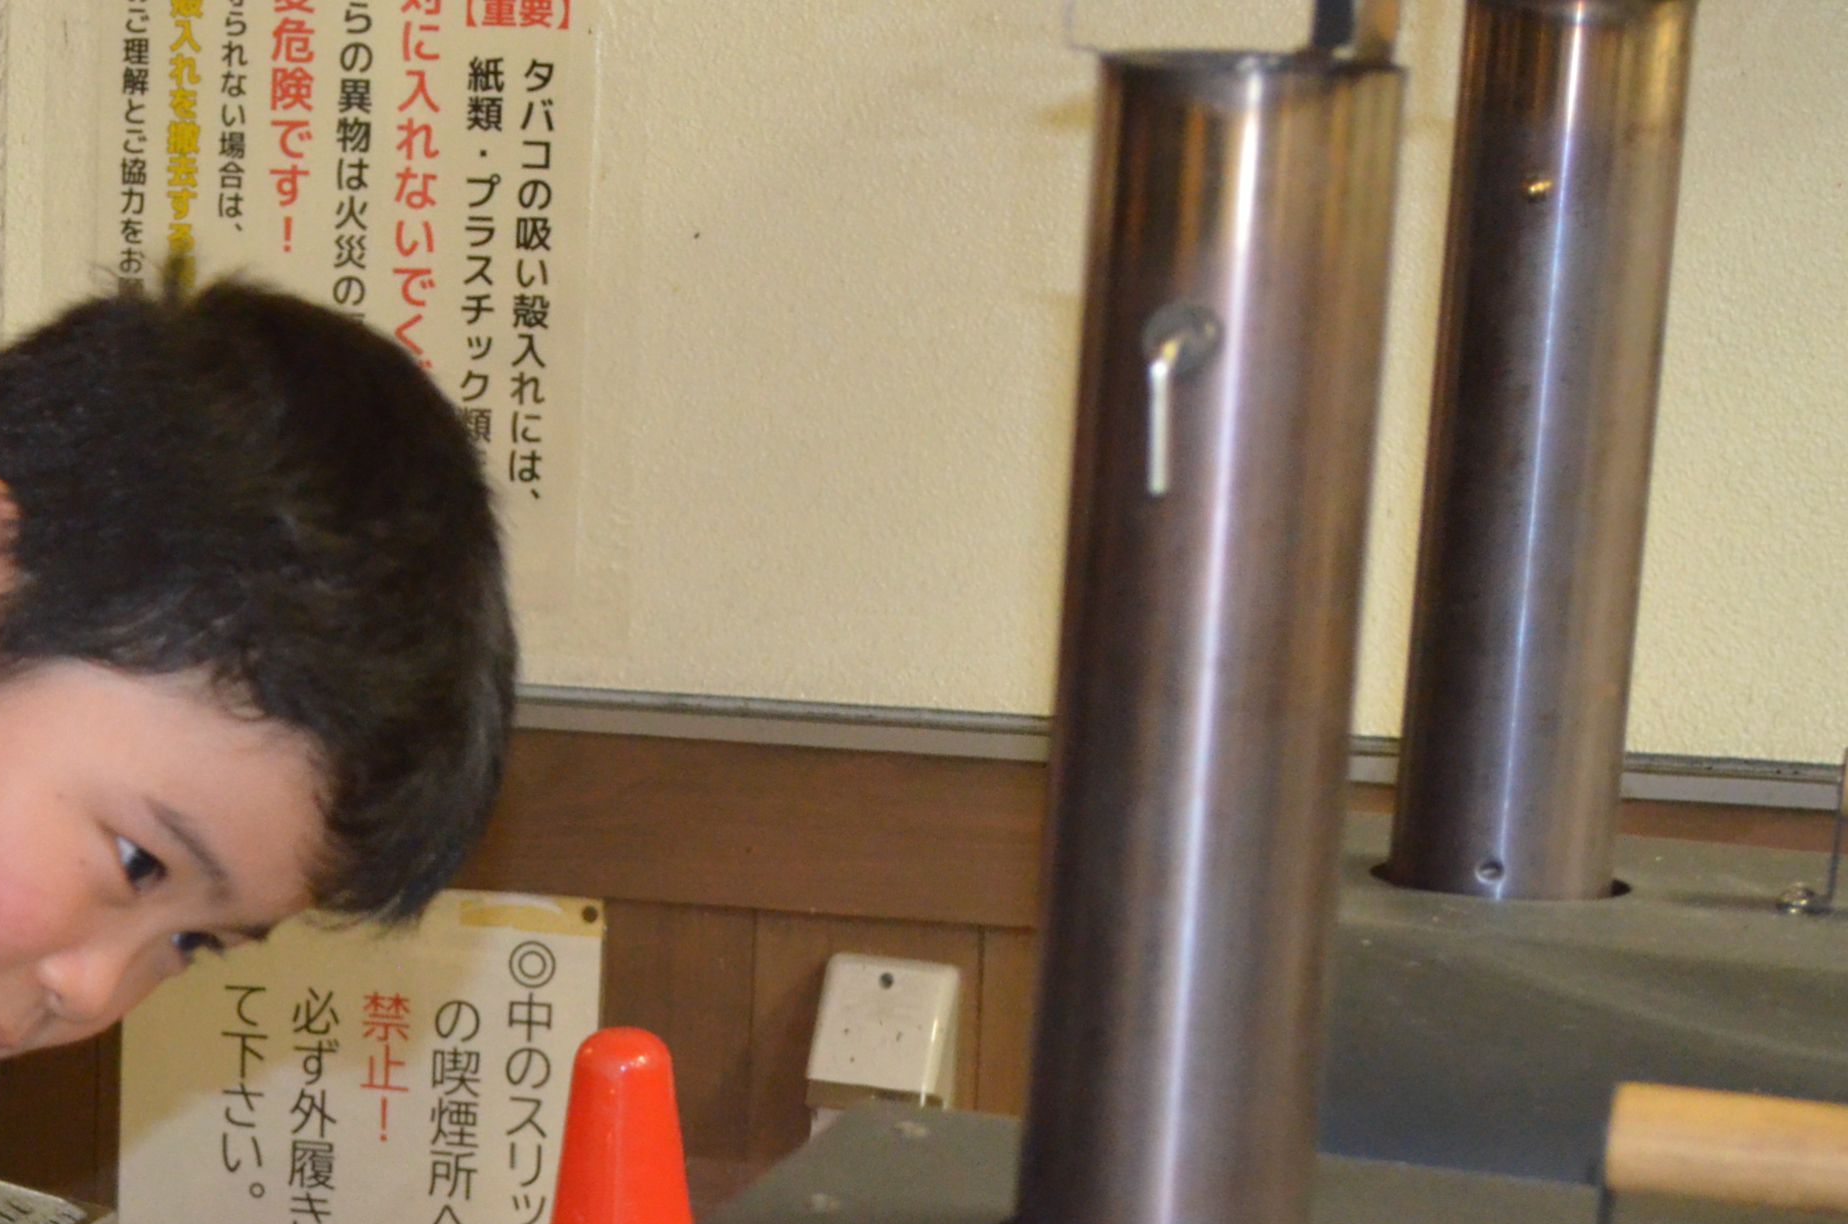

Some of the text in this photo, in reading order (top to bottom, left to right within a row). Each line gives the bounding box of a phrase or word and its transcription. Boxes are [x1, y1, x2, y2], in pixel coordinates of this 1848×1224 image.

[118, 0, 150, 298] ご理解とご協力をお
[218, 0, 248, 232] られない場合は、
[332, 2, 374, 322] らの異物は火災の
[392, 0, 441, 370] に入れないでく
[459, 56, 505, 460] 紙類・プラスチック類
[508, 58, 555, 500] タバコの吸い殻入れには、
[220, 984, 269, 1200] て下さい。
[360, 991, 411, 1143] 禁止！
